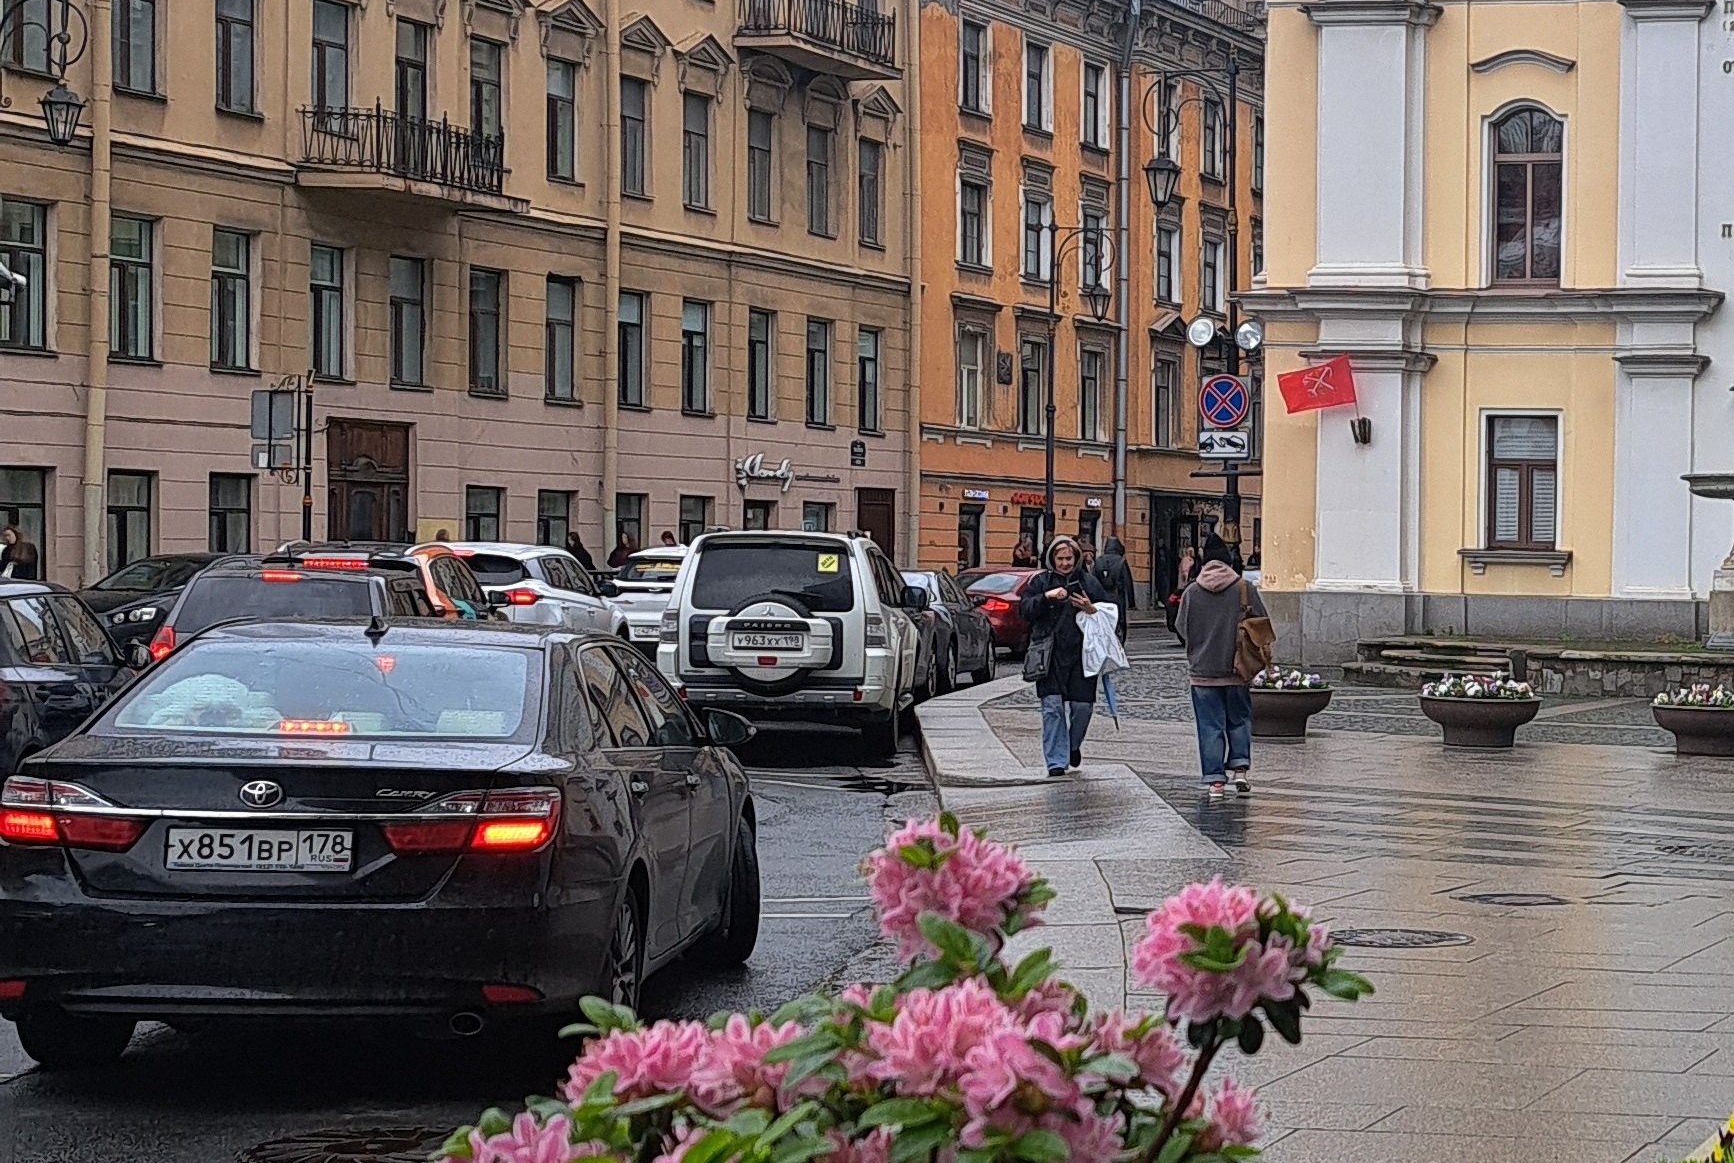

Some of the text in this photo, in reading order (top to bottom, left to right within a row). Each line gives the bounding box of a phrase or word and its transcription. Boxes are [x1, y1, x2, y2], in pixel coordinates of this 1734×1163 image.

[176, 833, 346, 862] Х851ВР 178
[310, 854, 333, 863] RUS
